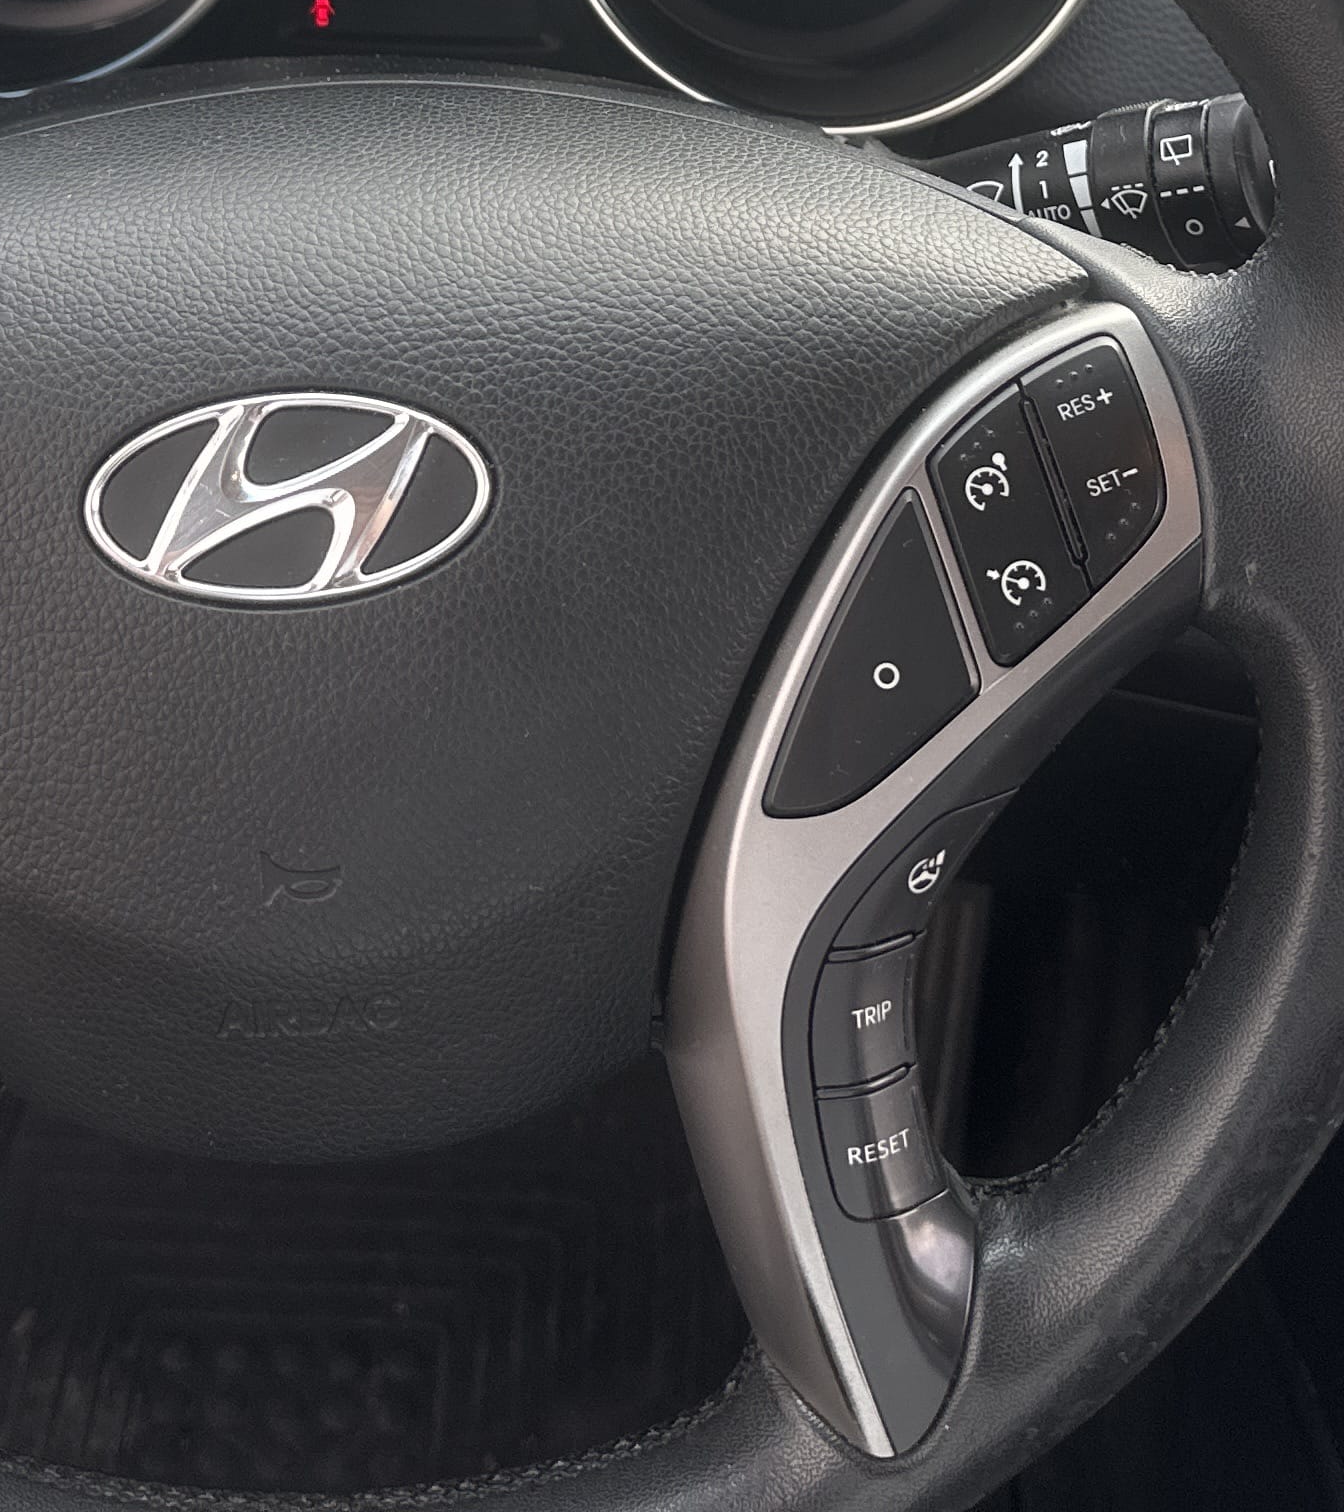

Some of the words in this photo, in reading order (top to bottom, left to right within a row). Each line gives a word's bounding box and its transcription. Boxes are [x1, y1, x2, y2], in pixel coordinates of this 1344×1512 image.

[1036, 150, 1049, 168] 2
[1039, 180, 1049, 199] 1
[852, 999, 893, 1029] TRIP
[847, 1128, 910, 1165] RESET
